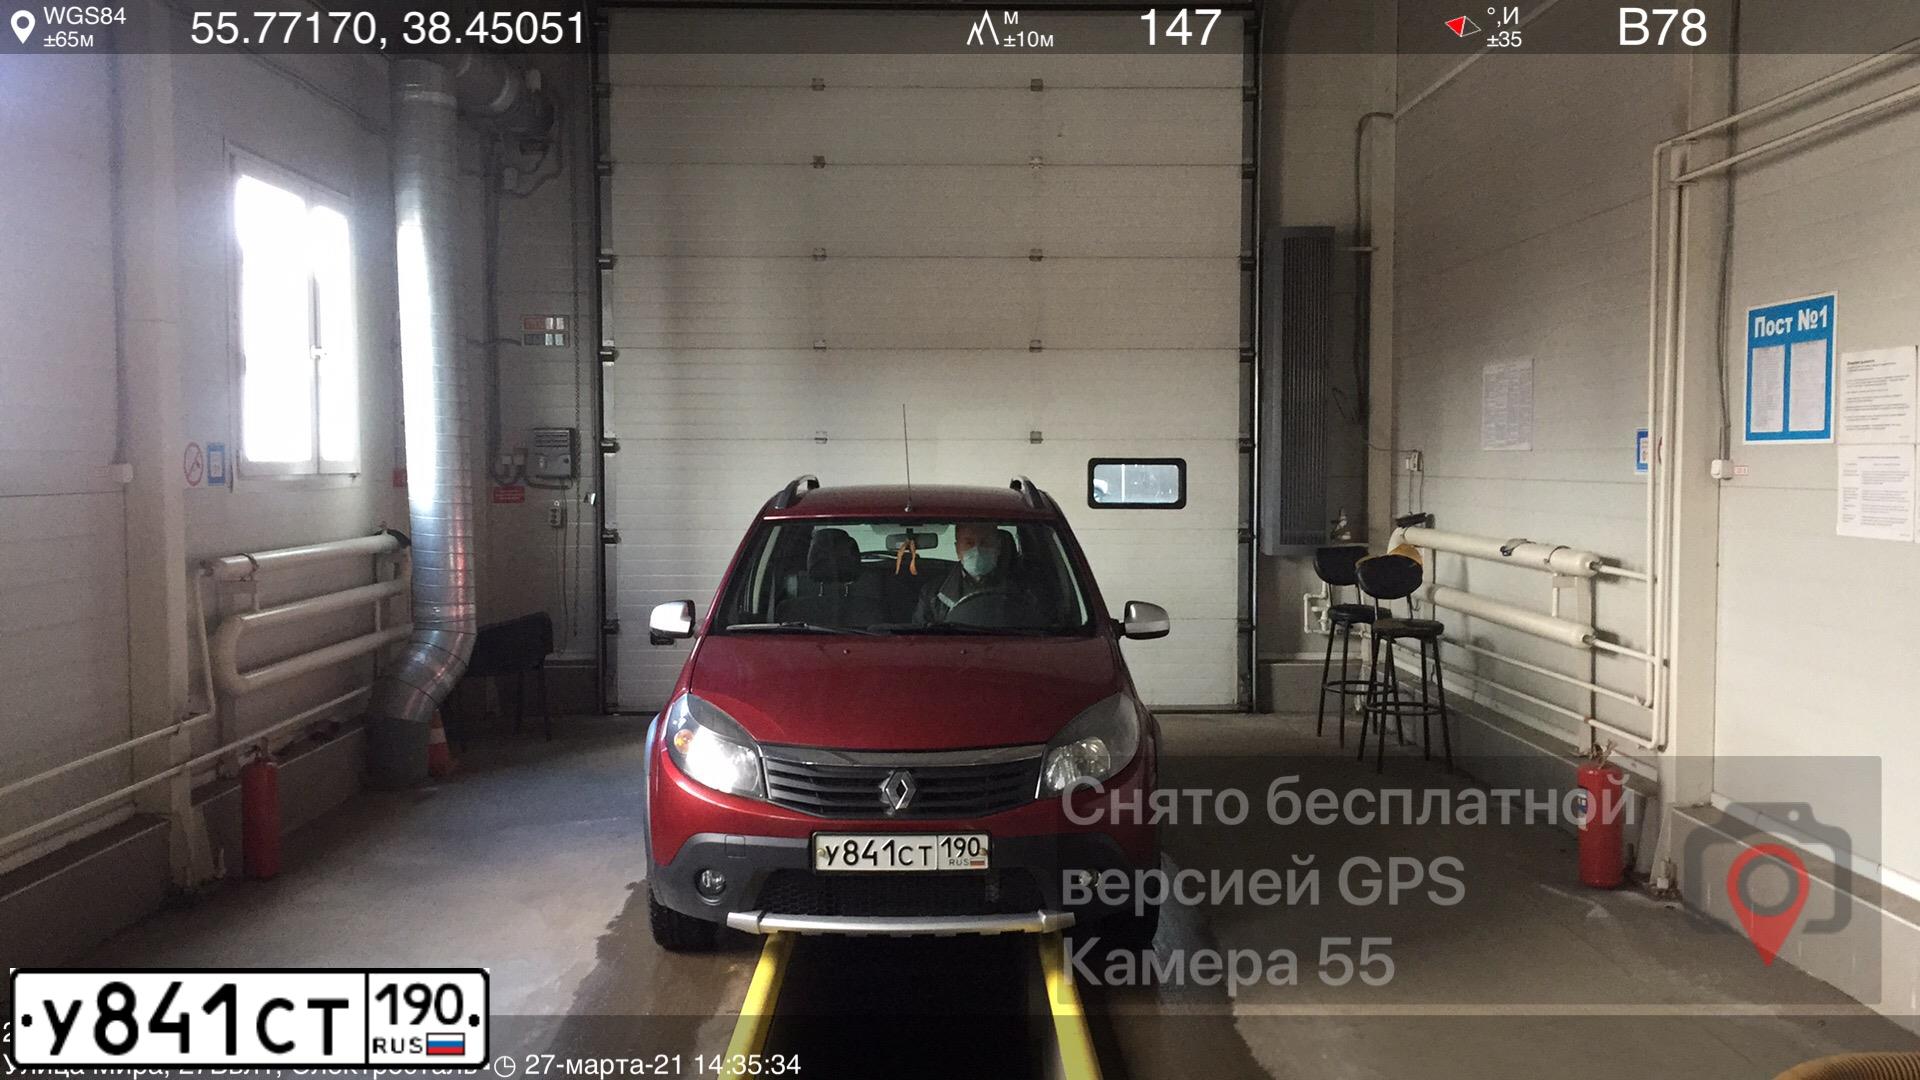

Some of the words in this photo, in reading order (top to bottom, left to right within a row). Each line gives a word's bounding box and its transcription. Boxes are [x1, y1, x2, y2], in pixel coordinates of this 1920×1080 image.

[1754, 316, 1793, 338] Пост
[1797, 304, 1828, 332] №1
[939, 836, 981, 858] 190
[948, 858, 970, 867] RUS
